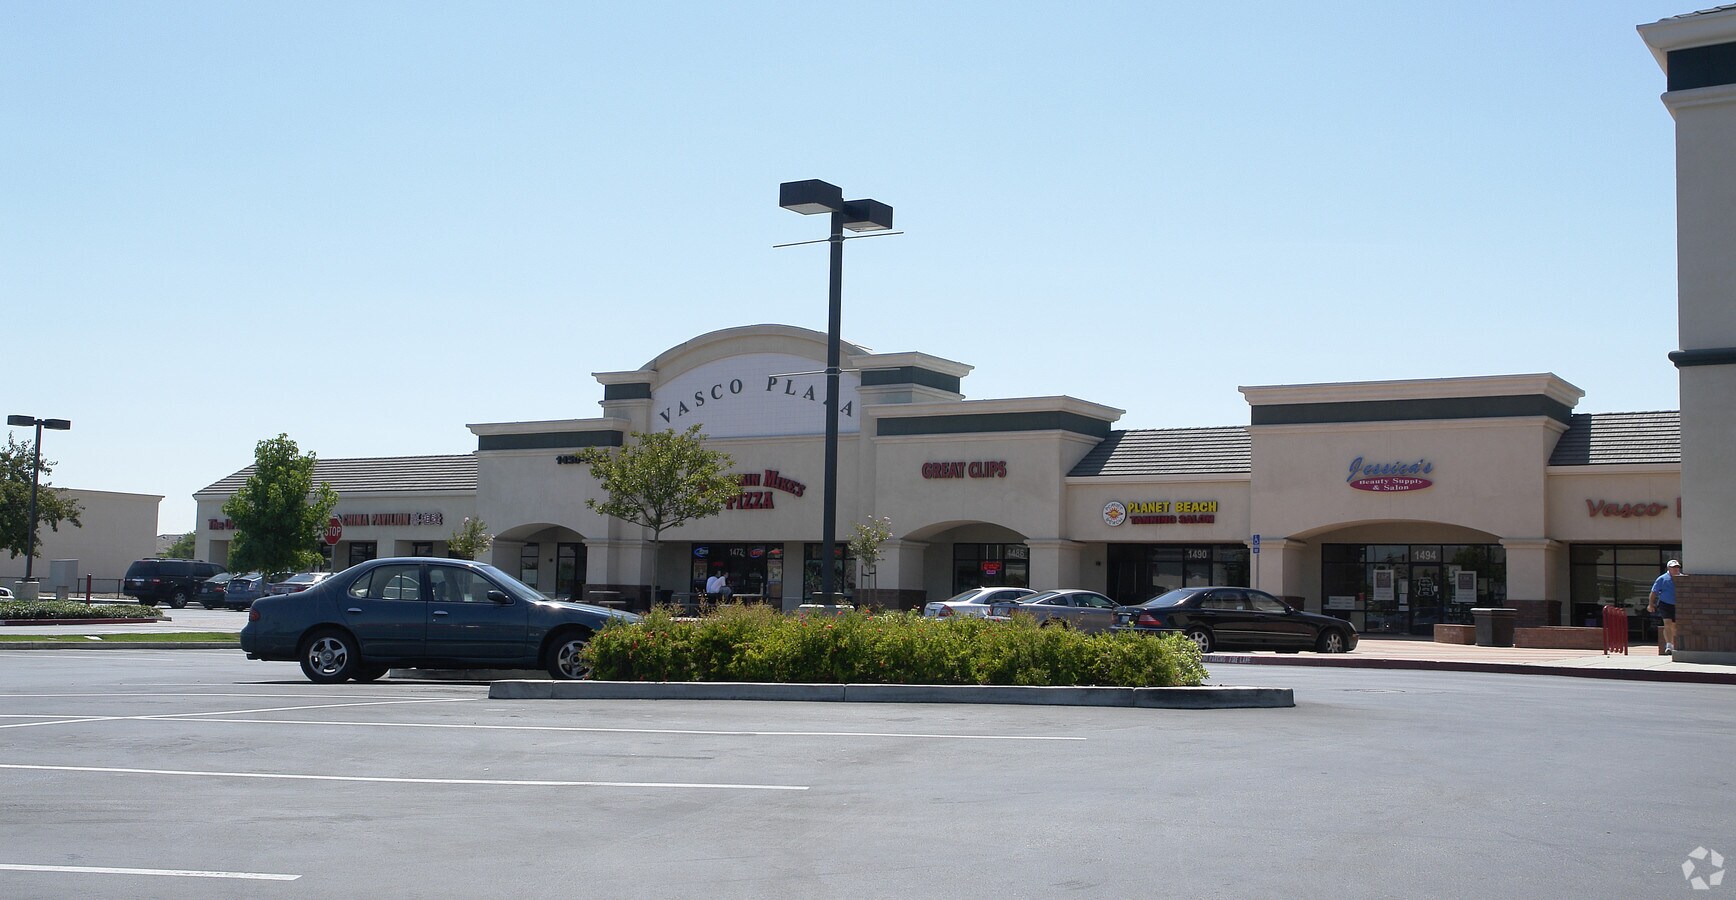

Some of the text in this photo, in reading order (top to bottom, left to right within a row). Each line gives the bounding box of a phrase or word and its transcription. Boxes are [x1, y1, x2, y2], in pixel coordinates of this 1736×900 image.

[659, 376, 853, 424] VASCO PLAA
[921, 461, 1007, 479] GREAT CLIPS
[1346, 457, 1433, 482] Jessica's
[1392, 477, 1423, 485] Supply
[725, 491, 775, 510] PIZZA
[1127, 501, 1218, 513] PLANET BEACH
[1585, 498, 1668, 518] Vasco
[341, 513, 370, 526] CHINA
[371, 513, 411, 526] PAVILION
[1129, 514, 1215, 525] TANNING SALON
[324, 526, 341, 537] STOP
[1188, 550, 1207, 559] 1490
[1414, 550, 1437, 560] 1494
